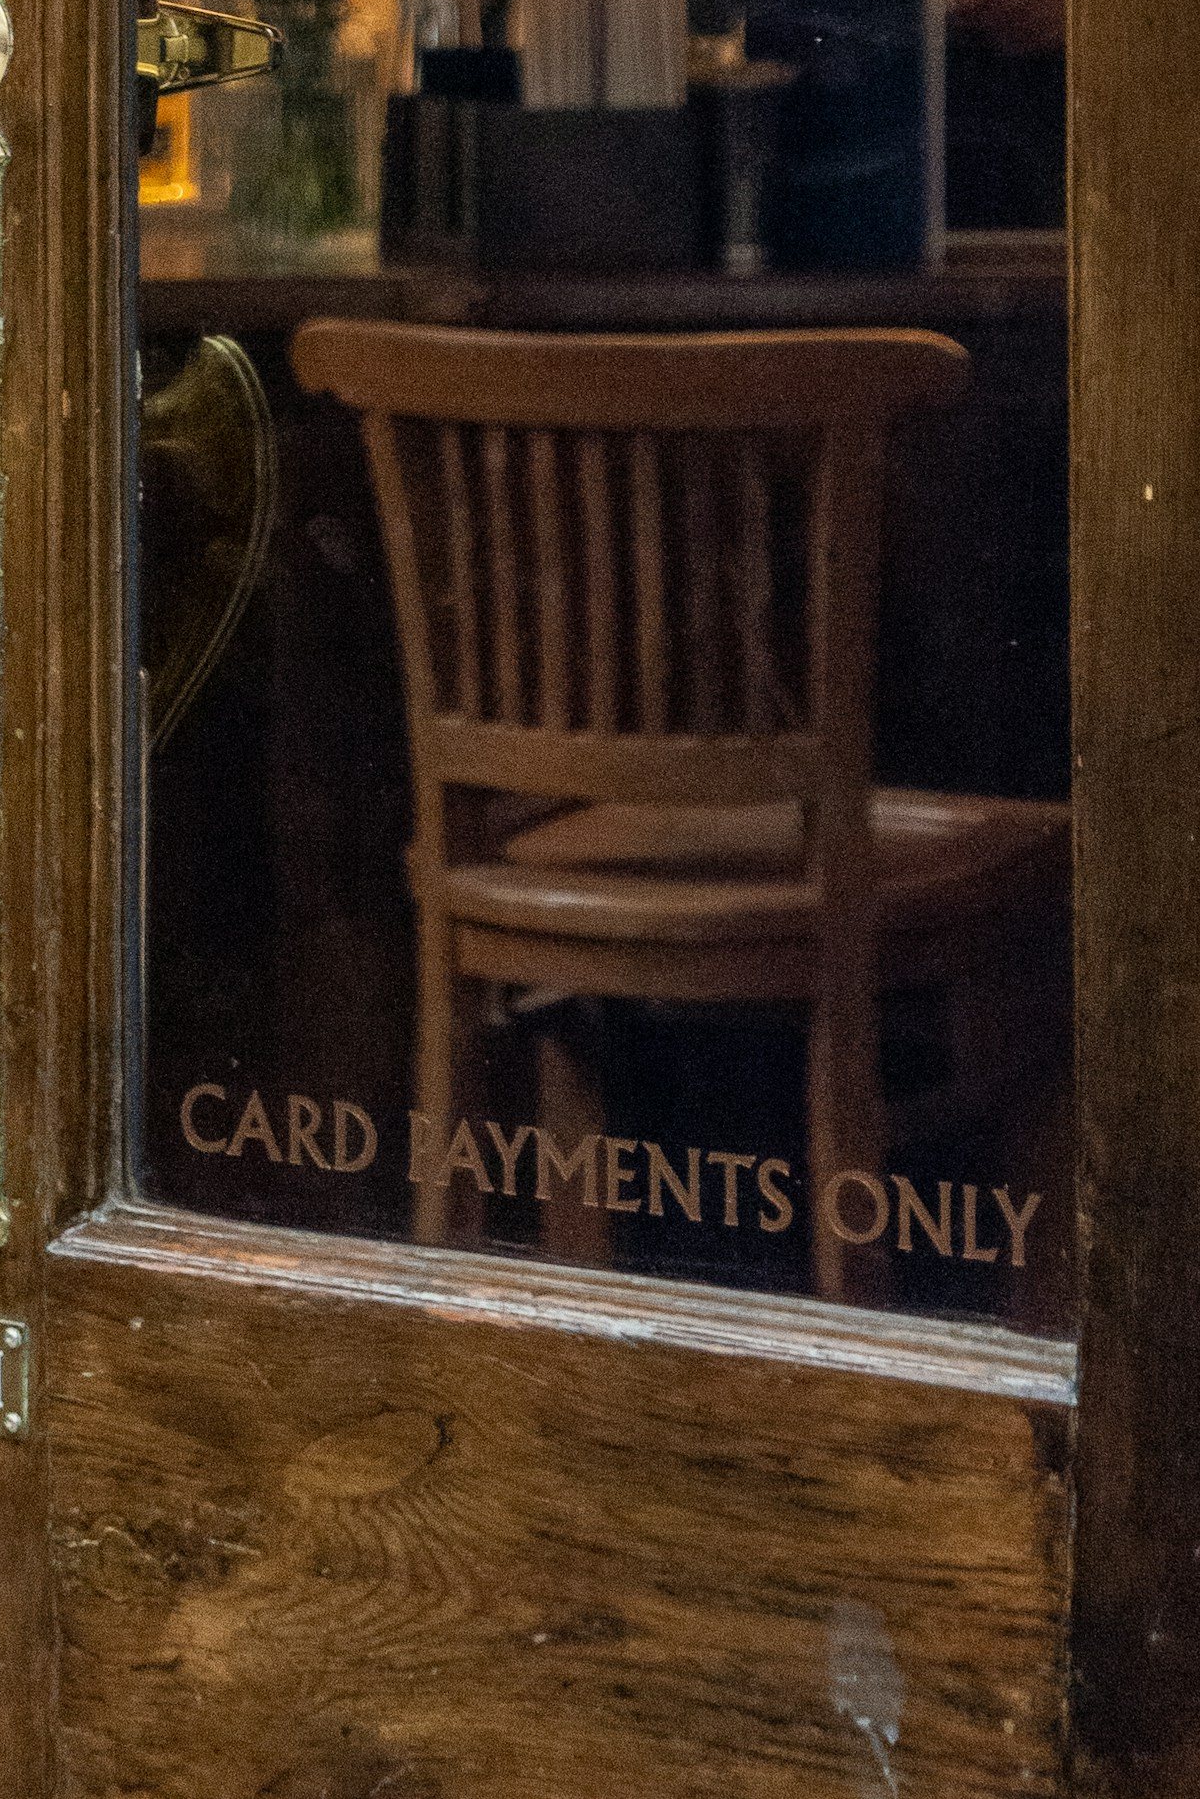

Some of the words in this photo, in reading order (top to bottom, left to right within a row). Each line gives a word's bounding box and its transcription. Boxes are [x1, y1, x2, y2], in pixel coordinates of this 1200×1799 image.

[180, 1083, 378, 1173] CARD
[408, 1109, 795, 1233] PAYMENTS
[824, 1168, 1042, 1268] ONLY
